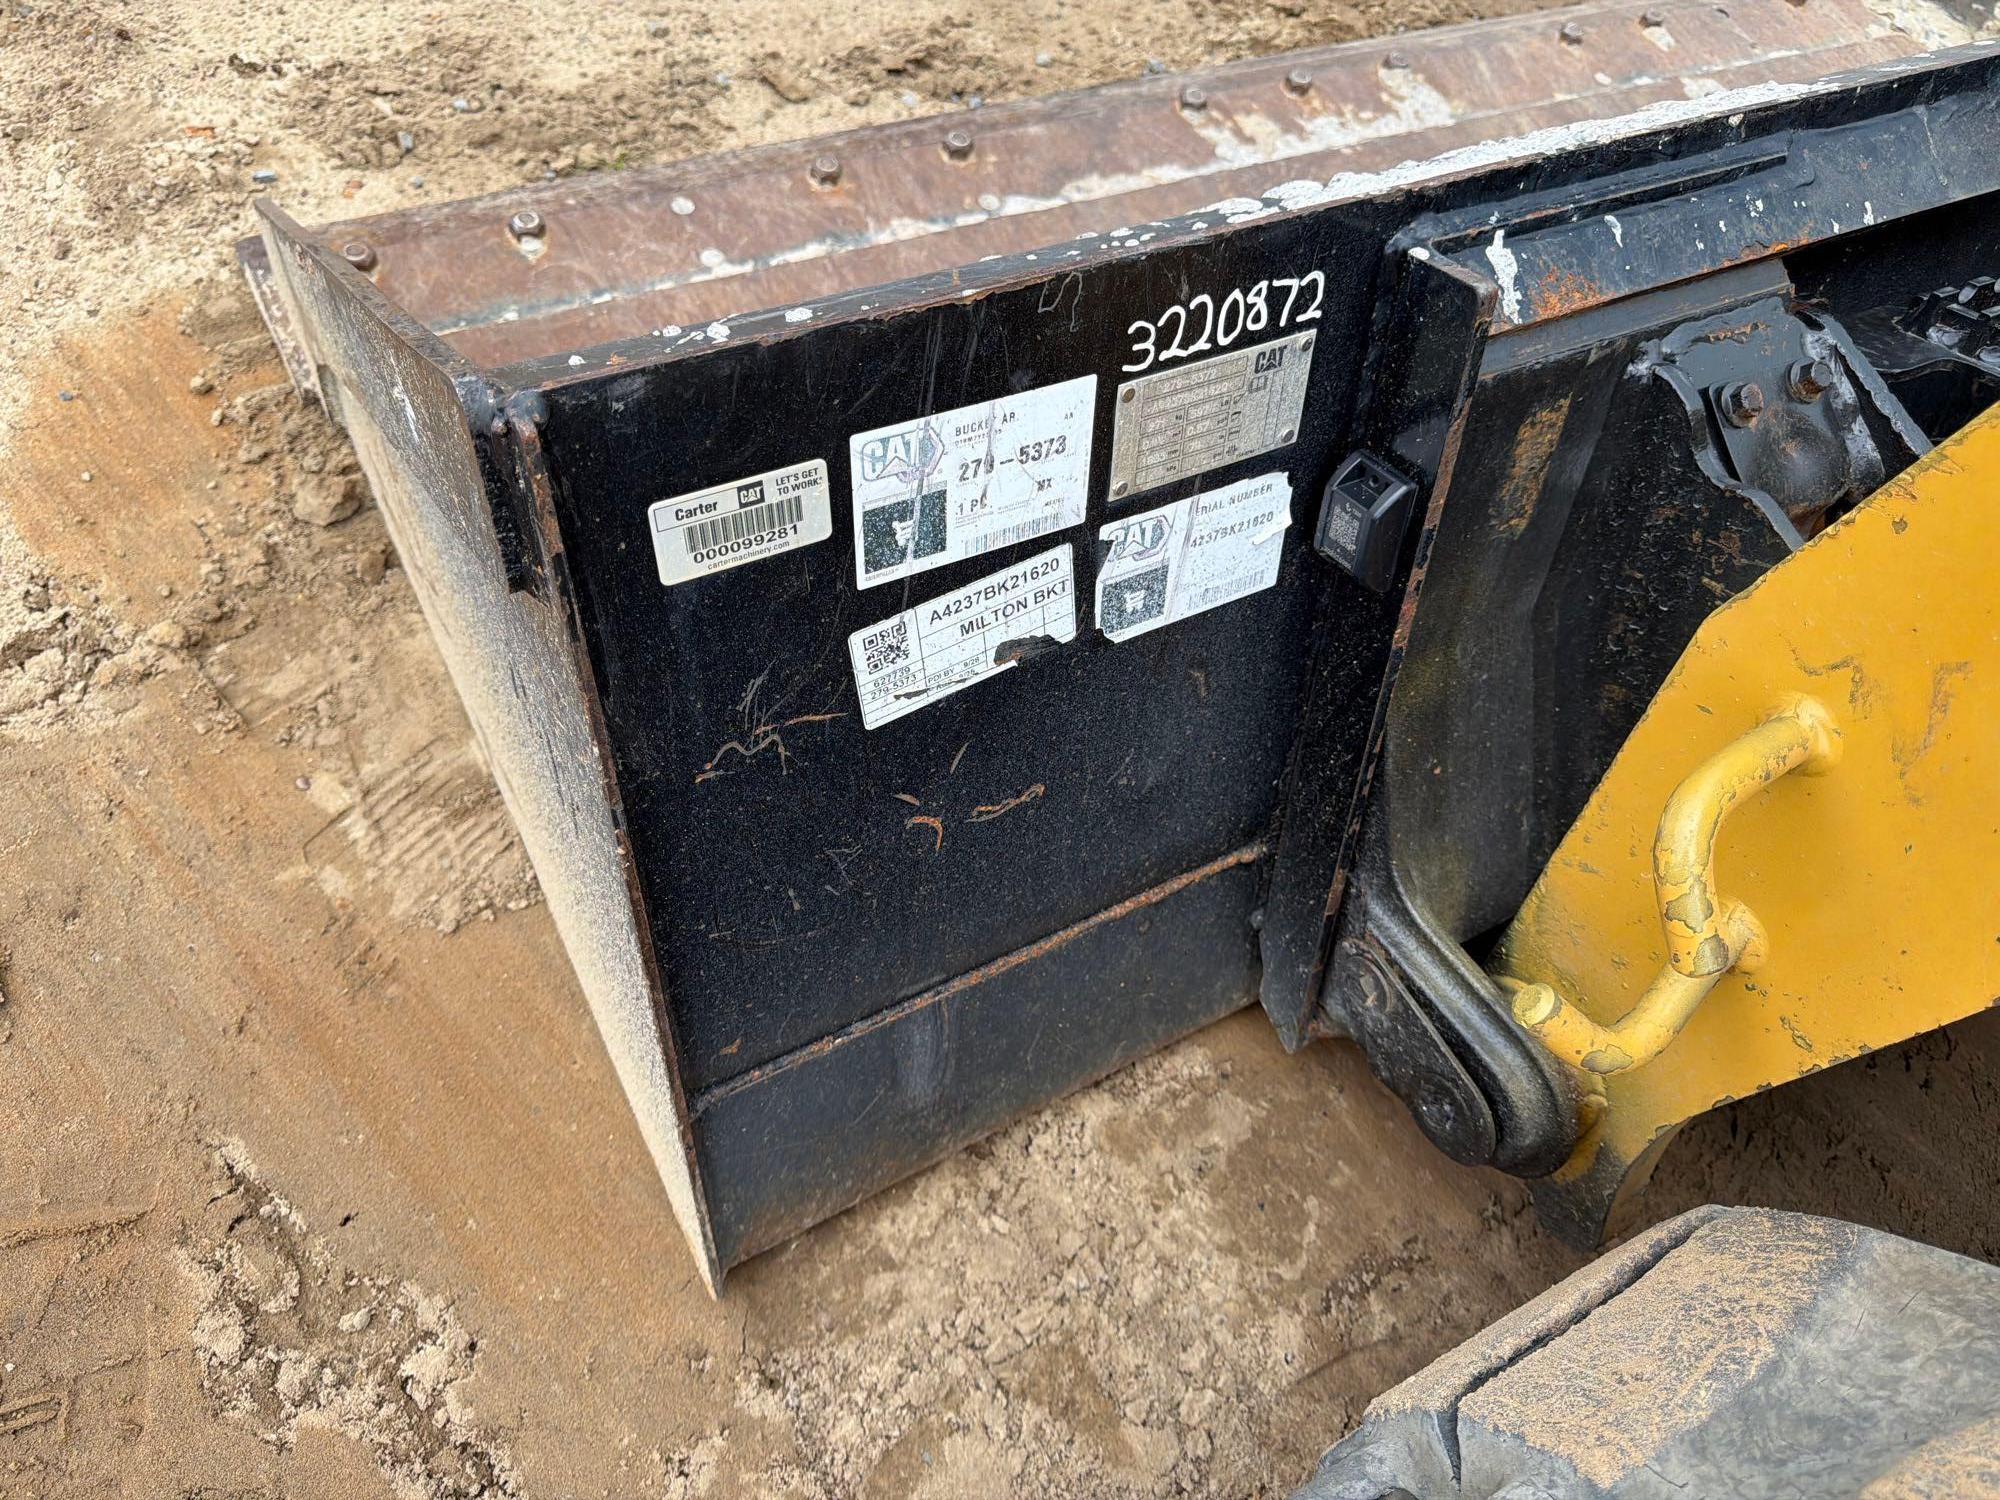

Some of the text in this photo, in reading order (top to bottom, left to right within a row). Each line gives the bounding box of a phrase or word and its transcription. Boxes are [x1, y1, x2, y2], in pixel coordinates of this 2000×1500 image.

[1122, 271, 1325, 372] 3220872
[1254, 345, 1288, 374] CAT
[862, 429, 923, 481] CAT
[775, 467, 818, 486] LET'S GET
[777, 486, 789, 496] TO
[740, 487, 763, 503] CAT
[1229, 483, 1273, 506] NUMBER
[674, 501, 718, 521] Carter
[693, 524, 798, 564] 000099281
[707, 541, 790, 571] cartermachinery.com
[929, 557, 1060, 625] A4237BK21620
[960, 578, 1070, 637] MILTON BKT
[873, 667, 911, 688] 627739
